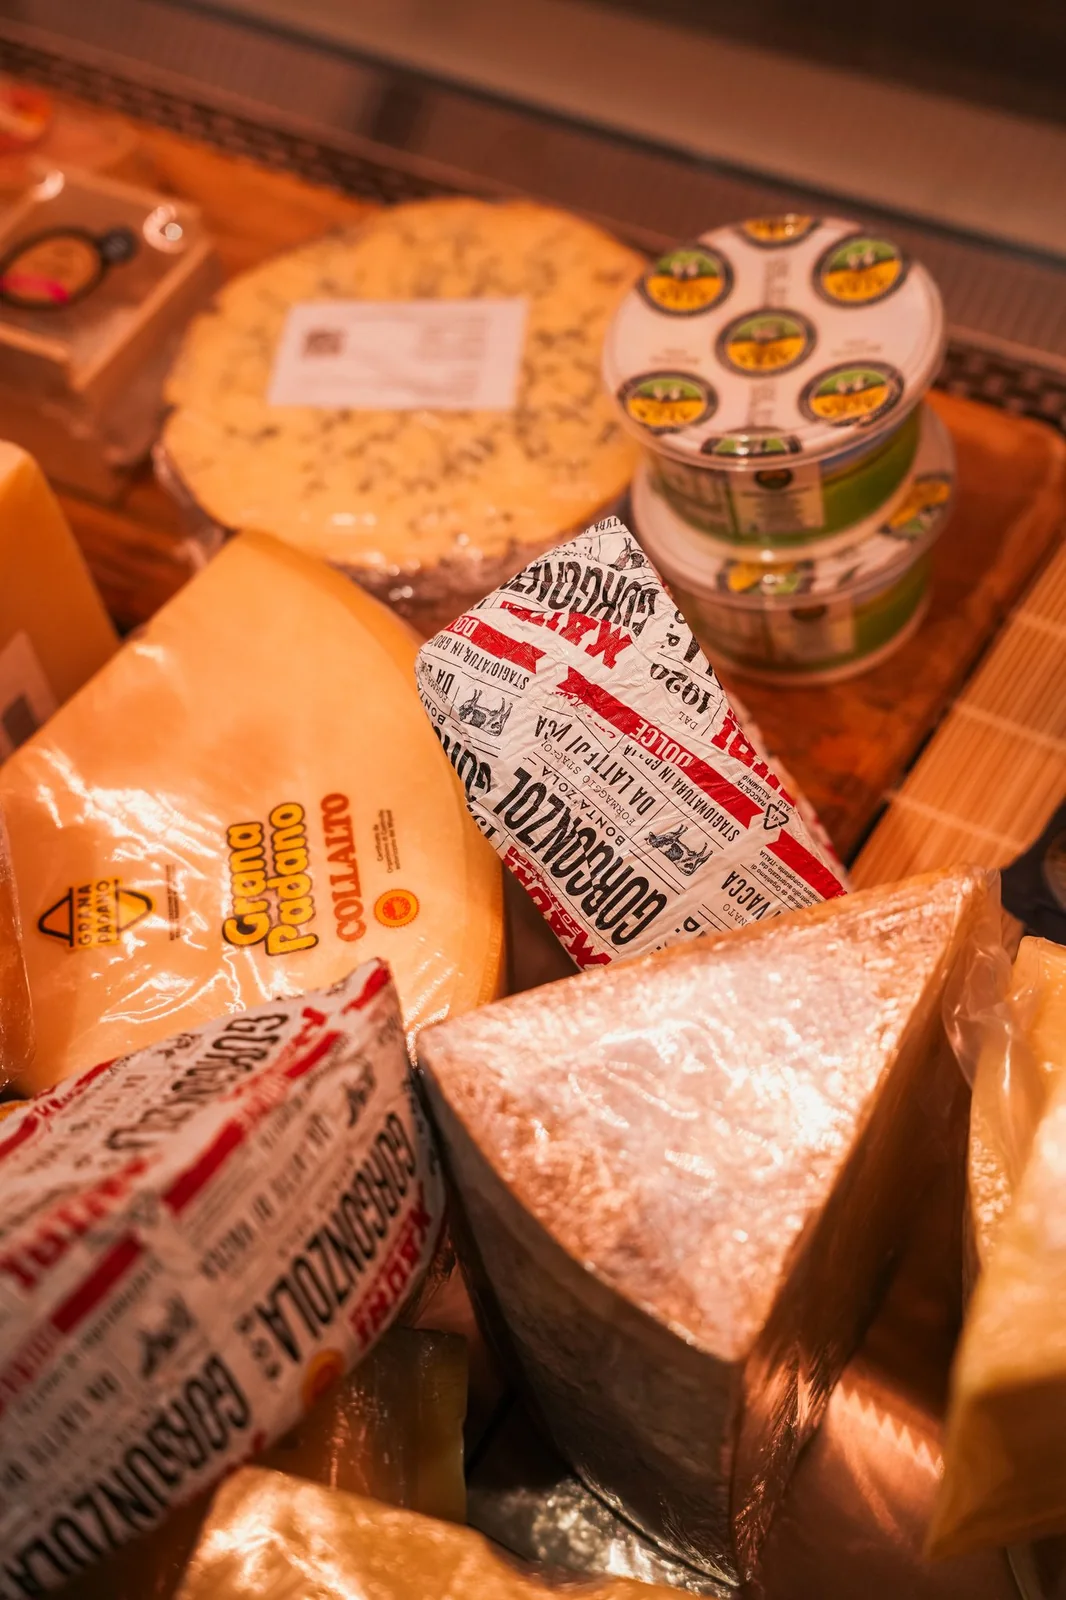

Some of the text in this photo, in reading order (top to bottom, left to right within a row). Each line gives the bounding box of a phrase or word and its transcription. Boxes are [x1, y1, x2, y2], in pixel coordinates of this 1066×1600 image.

[646, 662, 715, 715] 1920
[627, 718, 694, 769] DOLCE
[676, 709, 698, 729] DAL
[580, 773, 636, 827] FORMAGGIO
[625, 785, 656, 815] DA
[655, 764, 676, 784] IN
[735, 779, 766, 807] RACCOLTA
[667, 776, 740, 842] STAGIONATURA
[266, 802, 318, 955] Padano
[320, 791, 366, 941] COLLALTO
[491, 766, 666, 945] GORGONZOL
[758, 849, 776, 866] ITALIA
[96, 879, 111, 942] PADANO
[220, 821, 269, 947] Grana
[720, 869, 769, 919] VACCA
[77, 883, 92, 945] GRANA
[255, 1112, 423, 1363] GORGONZOLA
